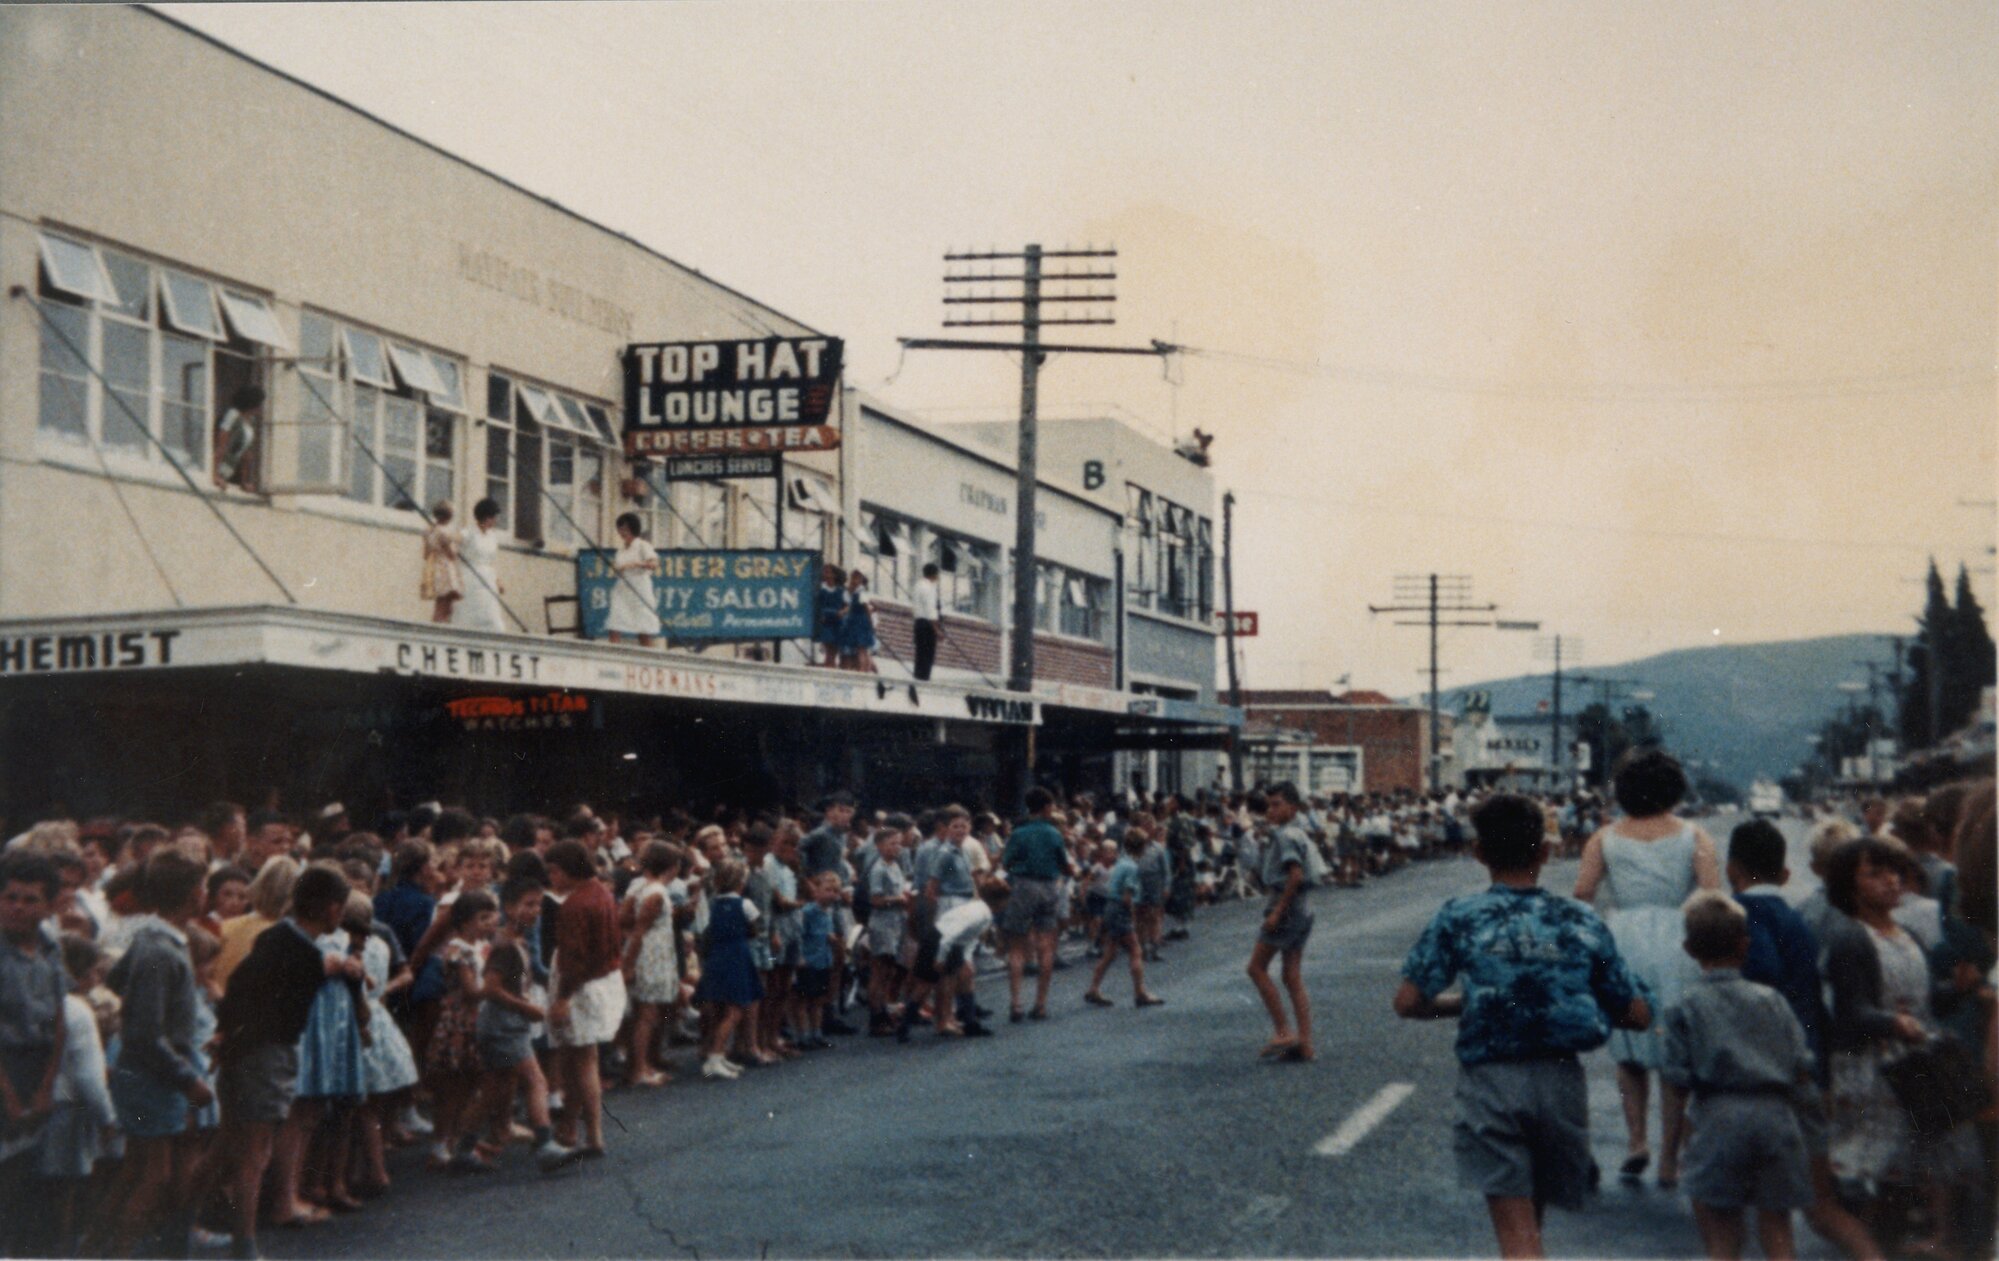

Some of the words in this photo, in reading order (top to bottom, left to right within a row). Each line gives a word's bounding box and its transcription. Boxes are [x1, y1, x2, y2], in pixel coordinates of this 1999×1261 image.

[636, 344, 719, 383] TOP
[736, 339, 828, 380] HAT
[639, 387, 800, 425] LOUNGE
[635, 428, 742, 451] COFFEE
[764, 426, 824, 447] TEA
[1082, 459, 1106, 491] B
[734, 554, 811, 579] GRAY
[704, 586, 800, 610] SALON
[397, 643, 540, 679] CHEMIST
